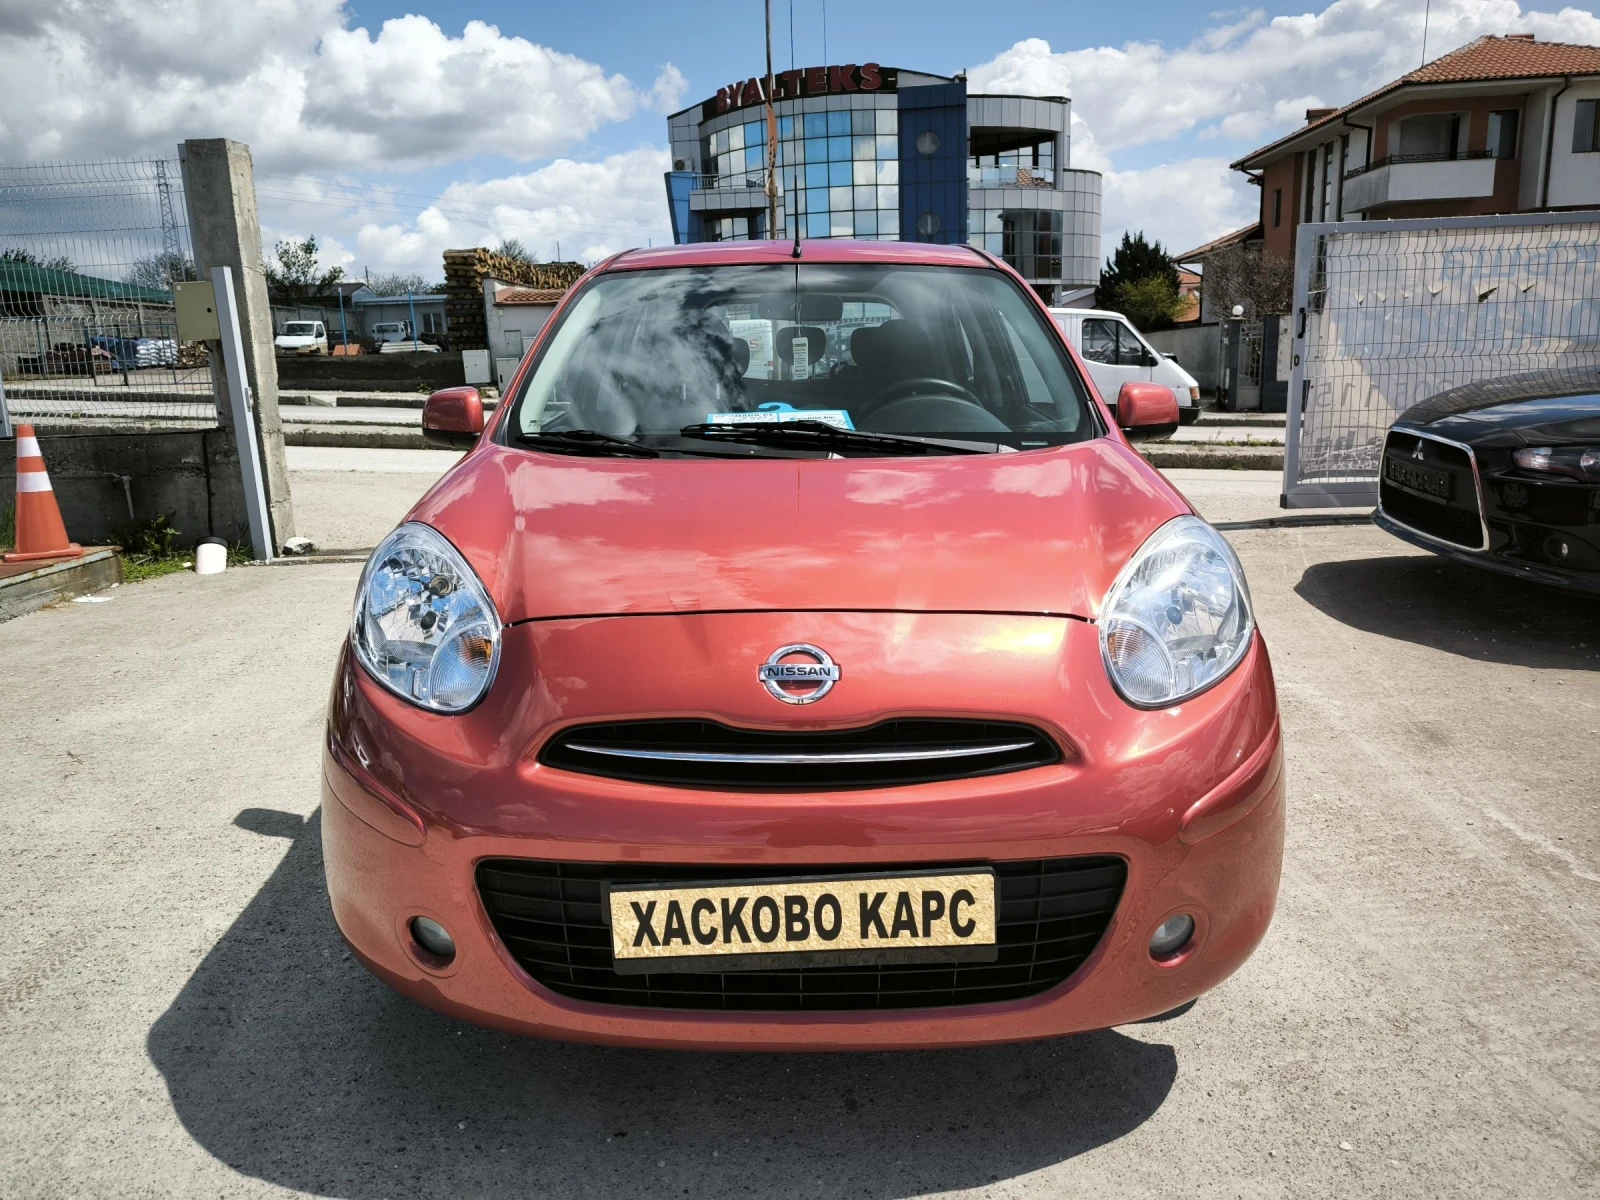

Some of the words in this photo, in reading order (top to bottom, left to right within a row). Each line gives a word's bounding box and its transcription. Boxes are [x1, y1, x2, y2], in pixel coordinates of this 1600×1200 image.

[716, 63, 882, 114] BYALTEKS
[767, 667, 831, 677] NISSAN
[629, 893, 843, 948] ХАСКОВО
[859, 888, 976, 940] КАРС
